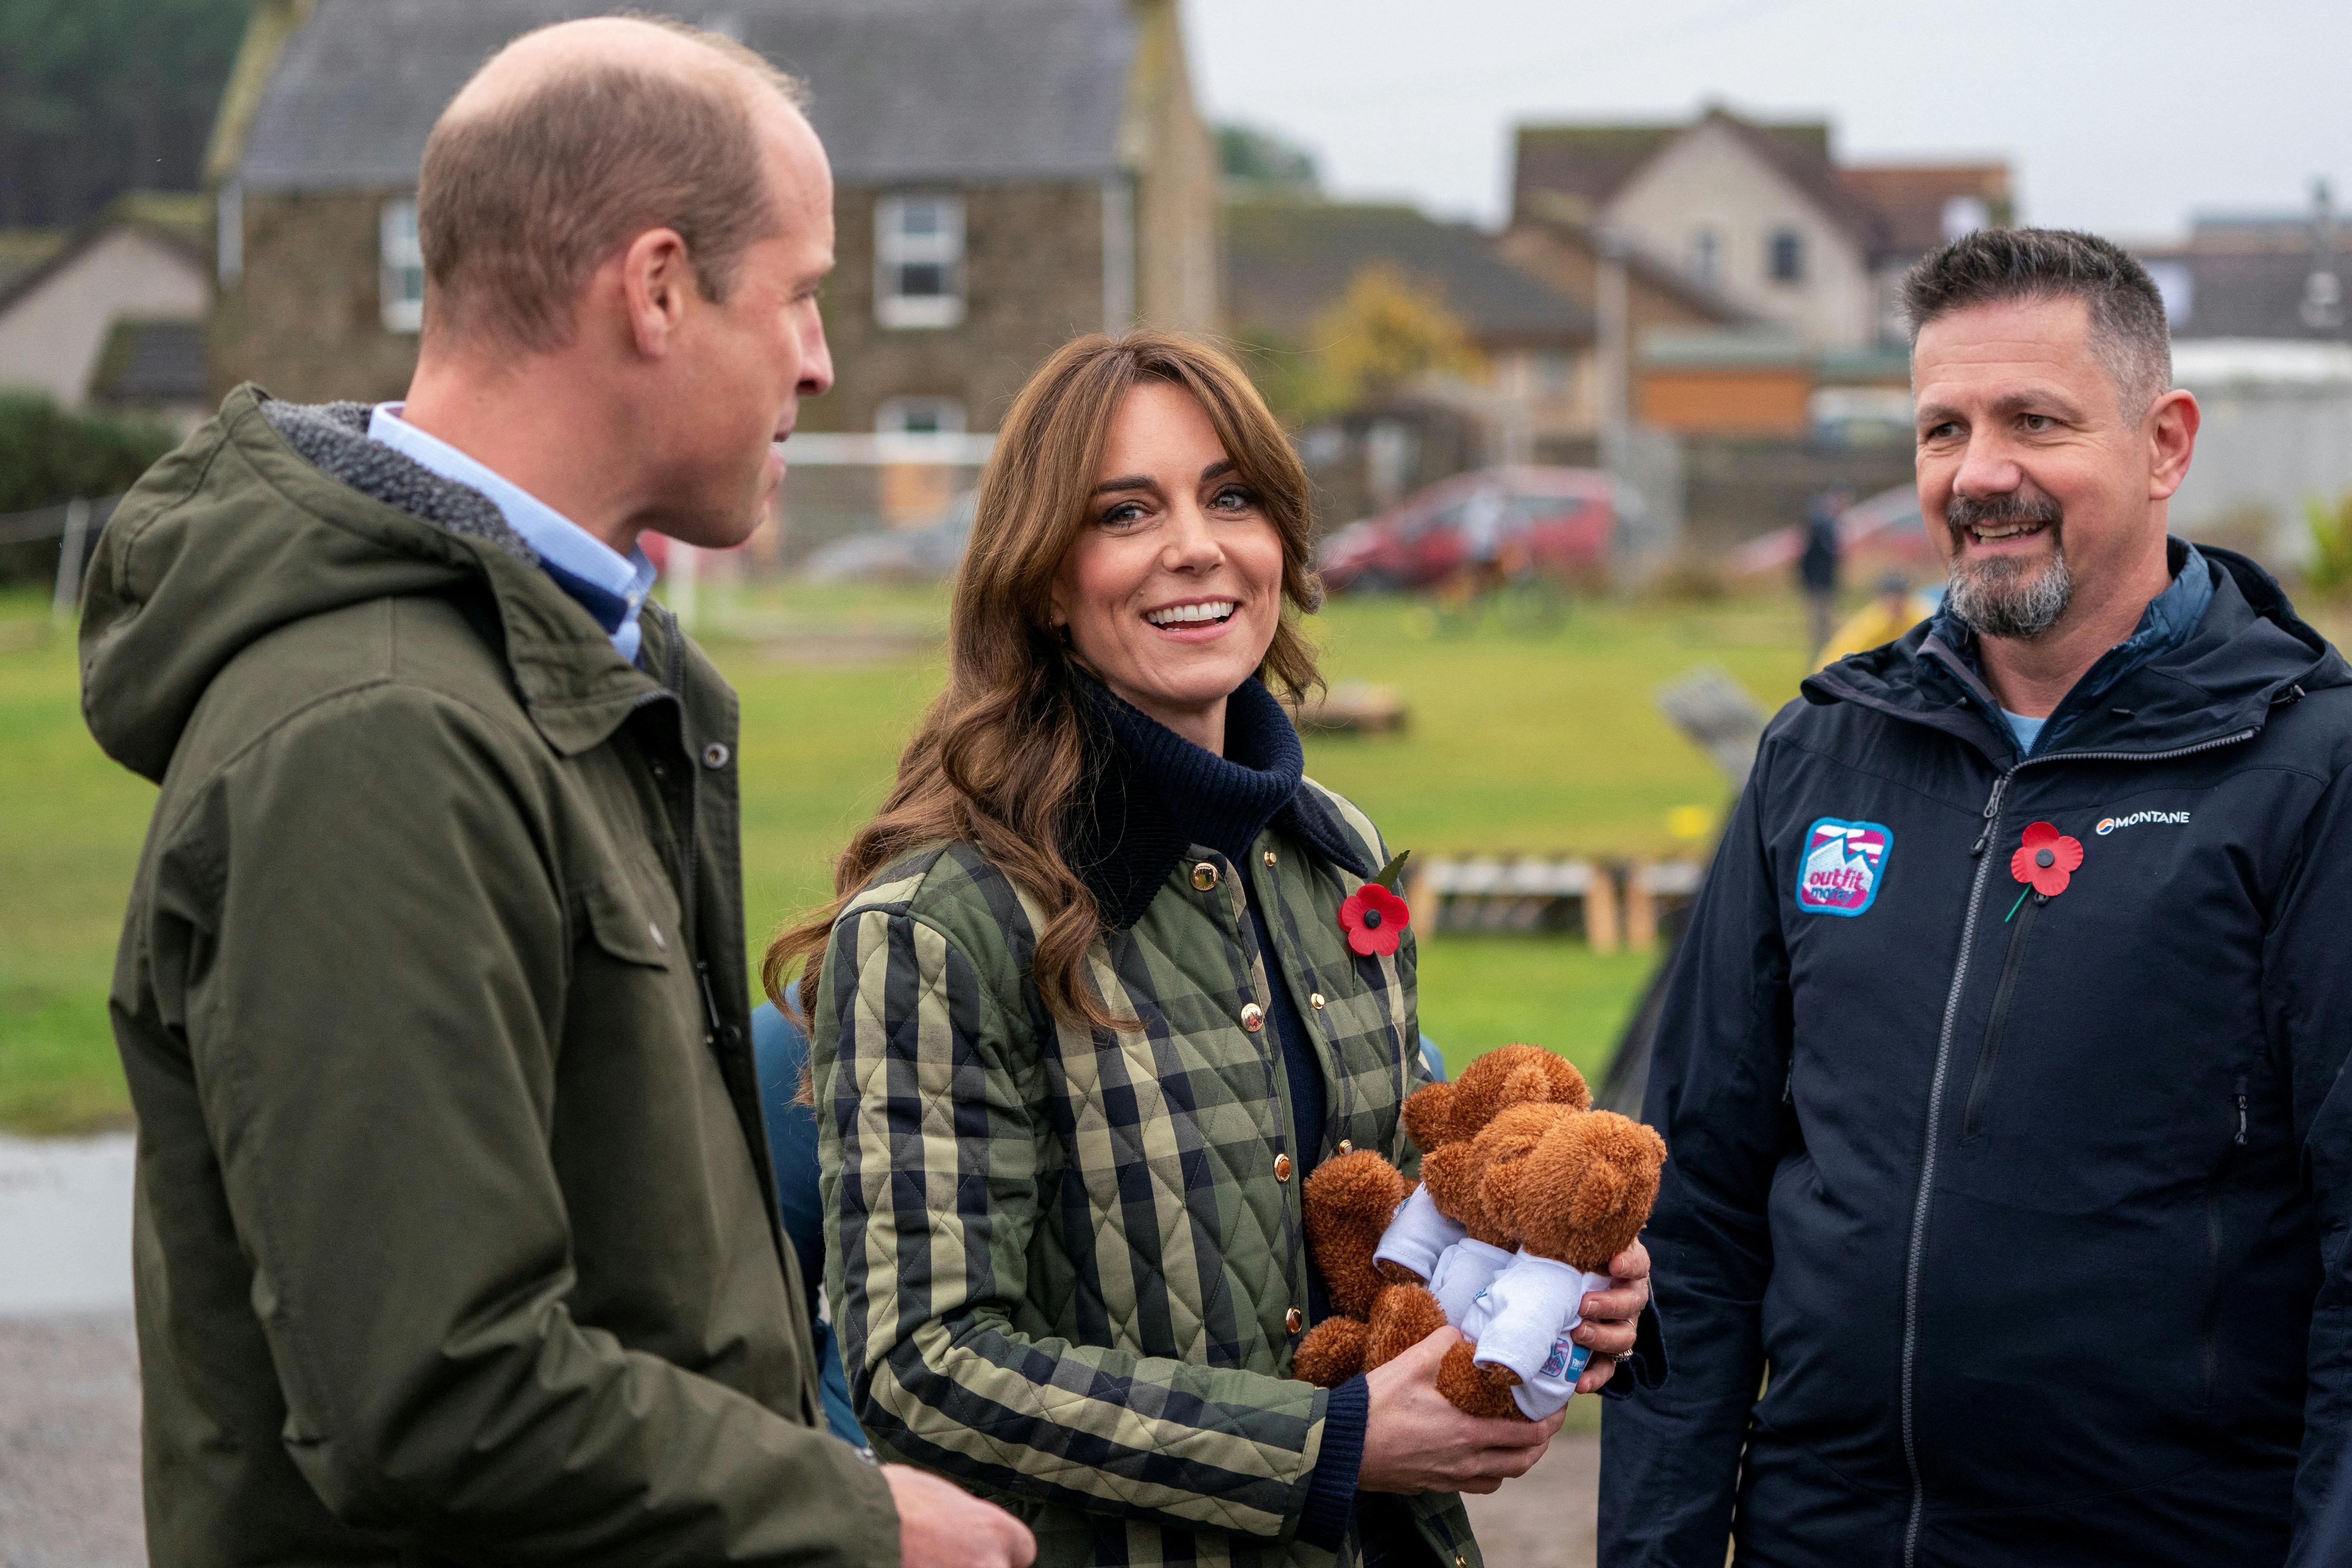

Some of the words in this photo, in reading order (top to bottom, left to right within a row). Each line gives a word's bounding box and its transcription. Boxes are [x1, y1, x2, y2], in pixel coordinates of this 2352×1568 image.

[2115, 810, 2191, 828] MONTANE
[1810, 868, 1864, 891] outfit
[1811, 888, 1856, 905] moray
